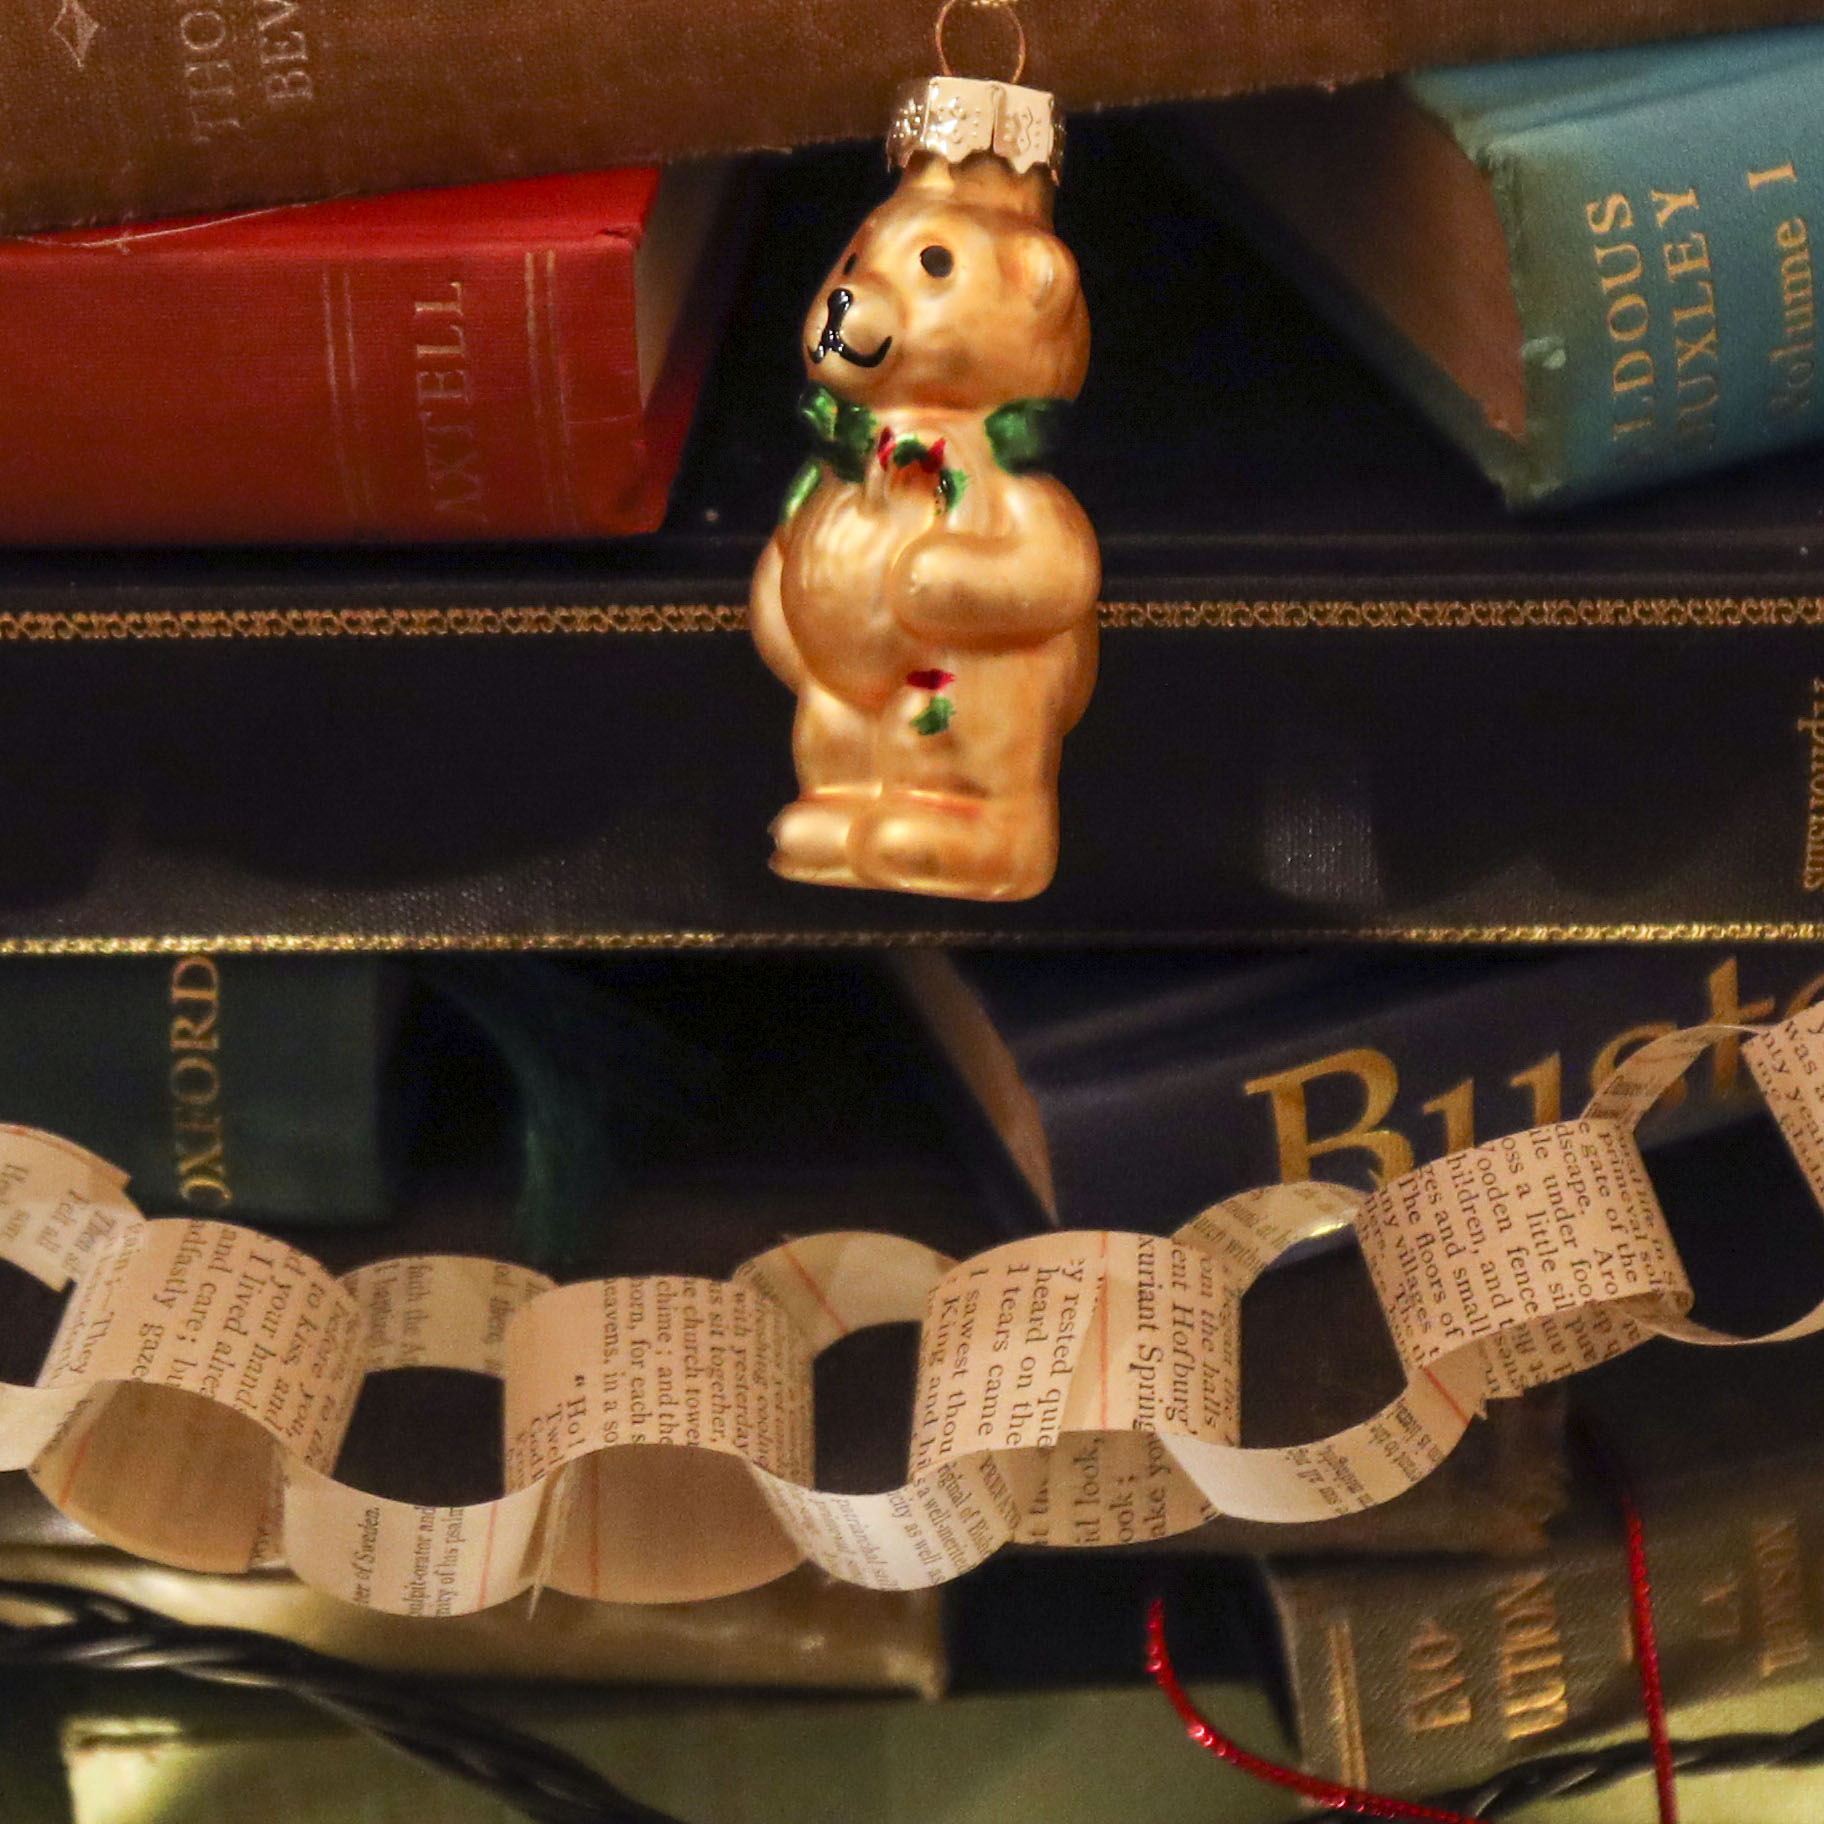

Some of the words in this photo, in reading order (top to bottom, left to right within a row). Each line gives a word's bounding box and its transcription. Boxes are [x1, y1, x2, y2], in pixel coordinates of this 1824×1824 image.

[1585, 192, 1656, 444] LDOUS
[170, 956, 232, 1207] OXFORD
[1525, 1209, 1559, 1272] little
[1542, 1174, 1578, 1249] under
[1580, 1144, 1611, 1198] gate
[1616, 1242, 1637, 1283] the
[990, 1280, 1019, 1352] tears
[1021, 1266, 1061, 1346] heard
[1415, 1232, 1447, 1305] floors
[1440, 1312, 1465, 1338] of
[1452, 1267, 1491, 1336] small
[1480, 1260, 1513, 1310] and
[630, 1339, 650, 1369] for
[683, 1305, 703, 1380] church
[1048, 1294, 1080, 1380] rested
[631, 1376, 650, 1425] each
[657, 1366, 677, 1407] and
[708, 1346, 730, 1443] together,
[976, 1364, 1005, 1438] came
[1007, 1396, 1033, 1448] the
[1129, 1342, 1163, 1432] Spring
